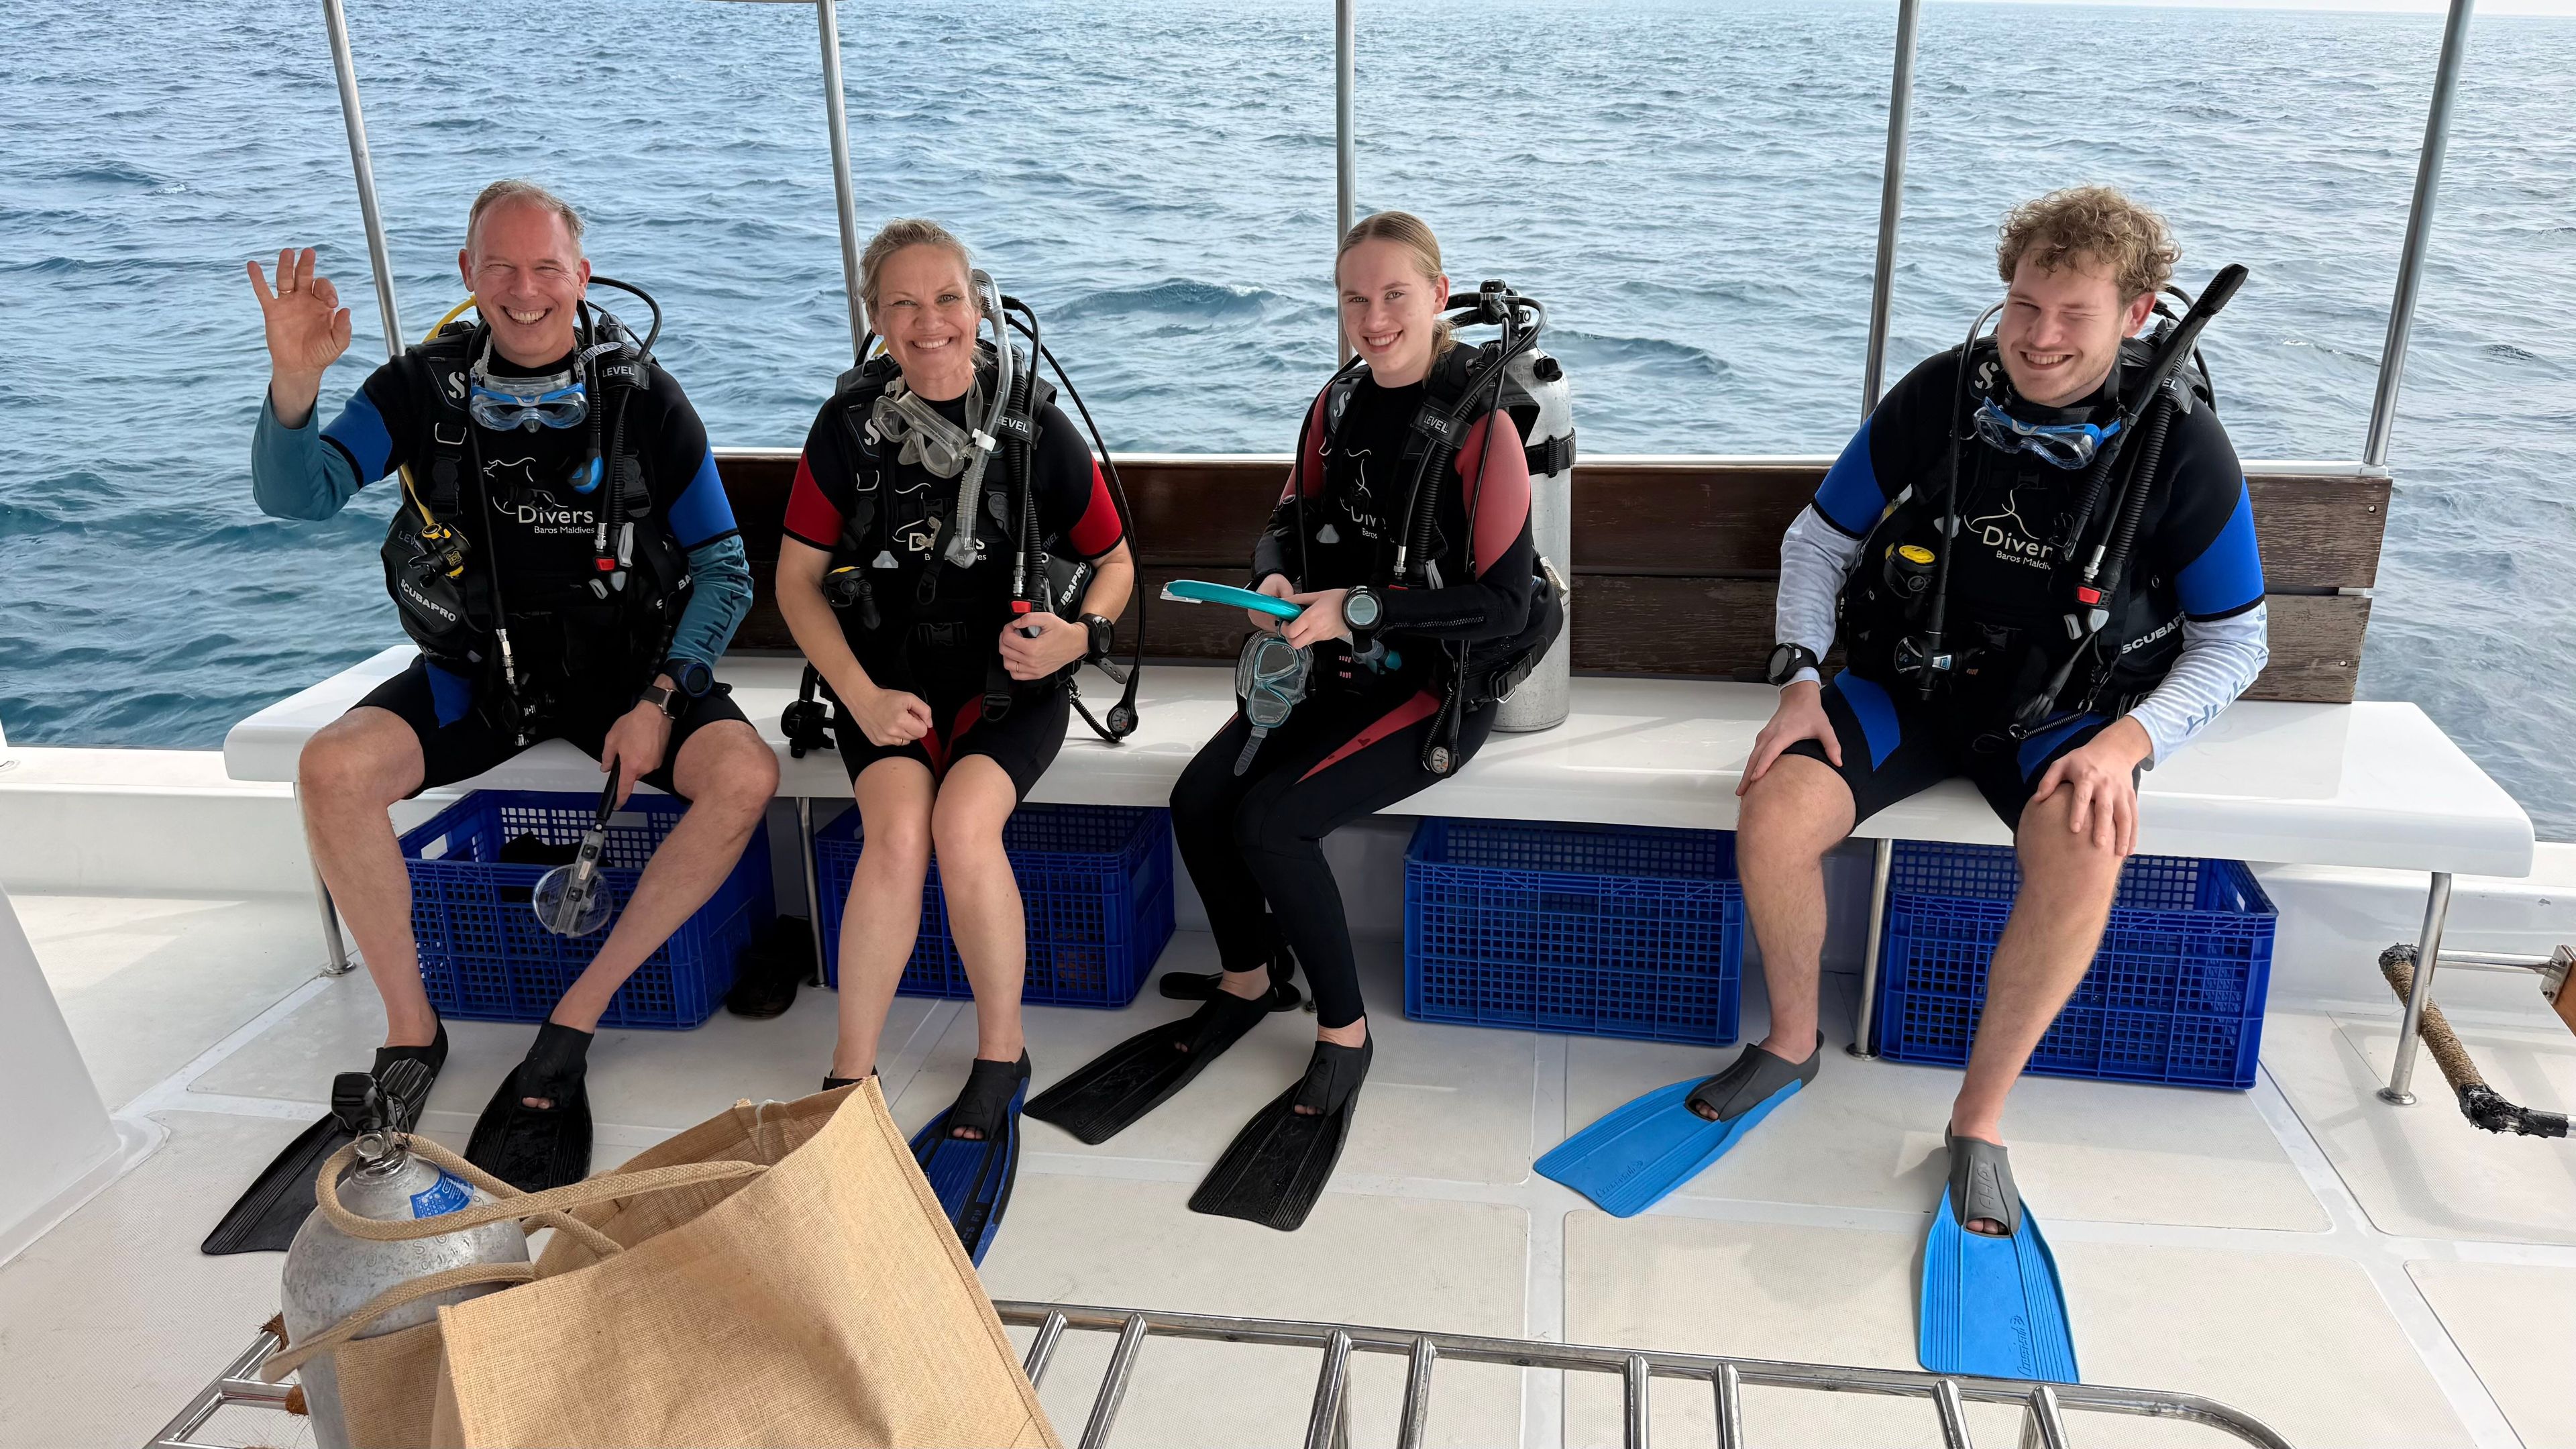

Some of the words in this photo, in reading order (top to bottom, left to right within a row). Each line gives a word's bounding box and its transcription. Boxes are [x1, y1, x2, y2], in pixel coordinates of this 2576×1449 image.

[602, 366, 635, 378] LEVEL
[1424, 413, 1449, 434] LEVEL
[518, 504, 594, 524] Divers
[534, 526, 557, 534] Baros
[560, 526, 595, 534] Maldives
[1983, 525, 2053, 558] Diver
[1996, 550, 2021, 563] Baros
[2023, 557, 2051, 571] Maldiv
[400, 578, 456, 622] SCUBAPRO
[2122, 610, 2186, 655] SCUBAPR
